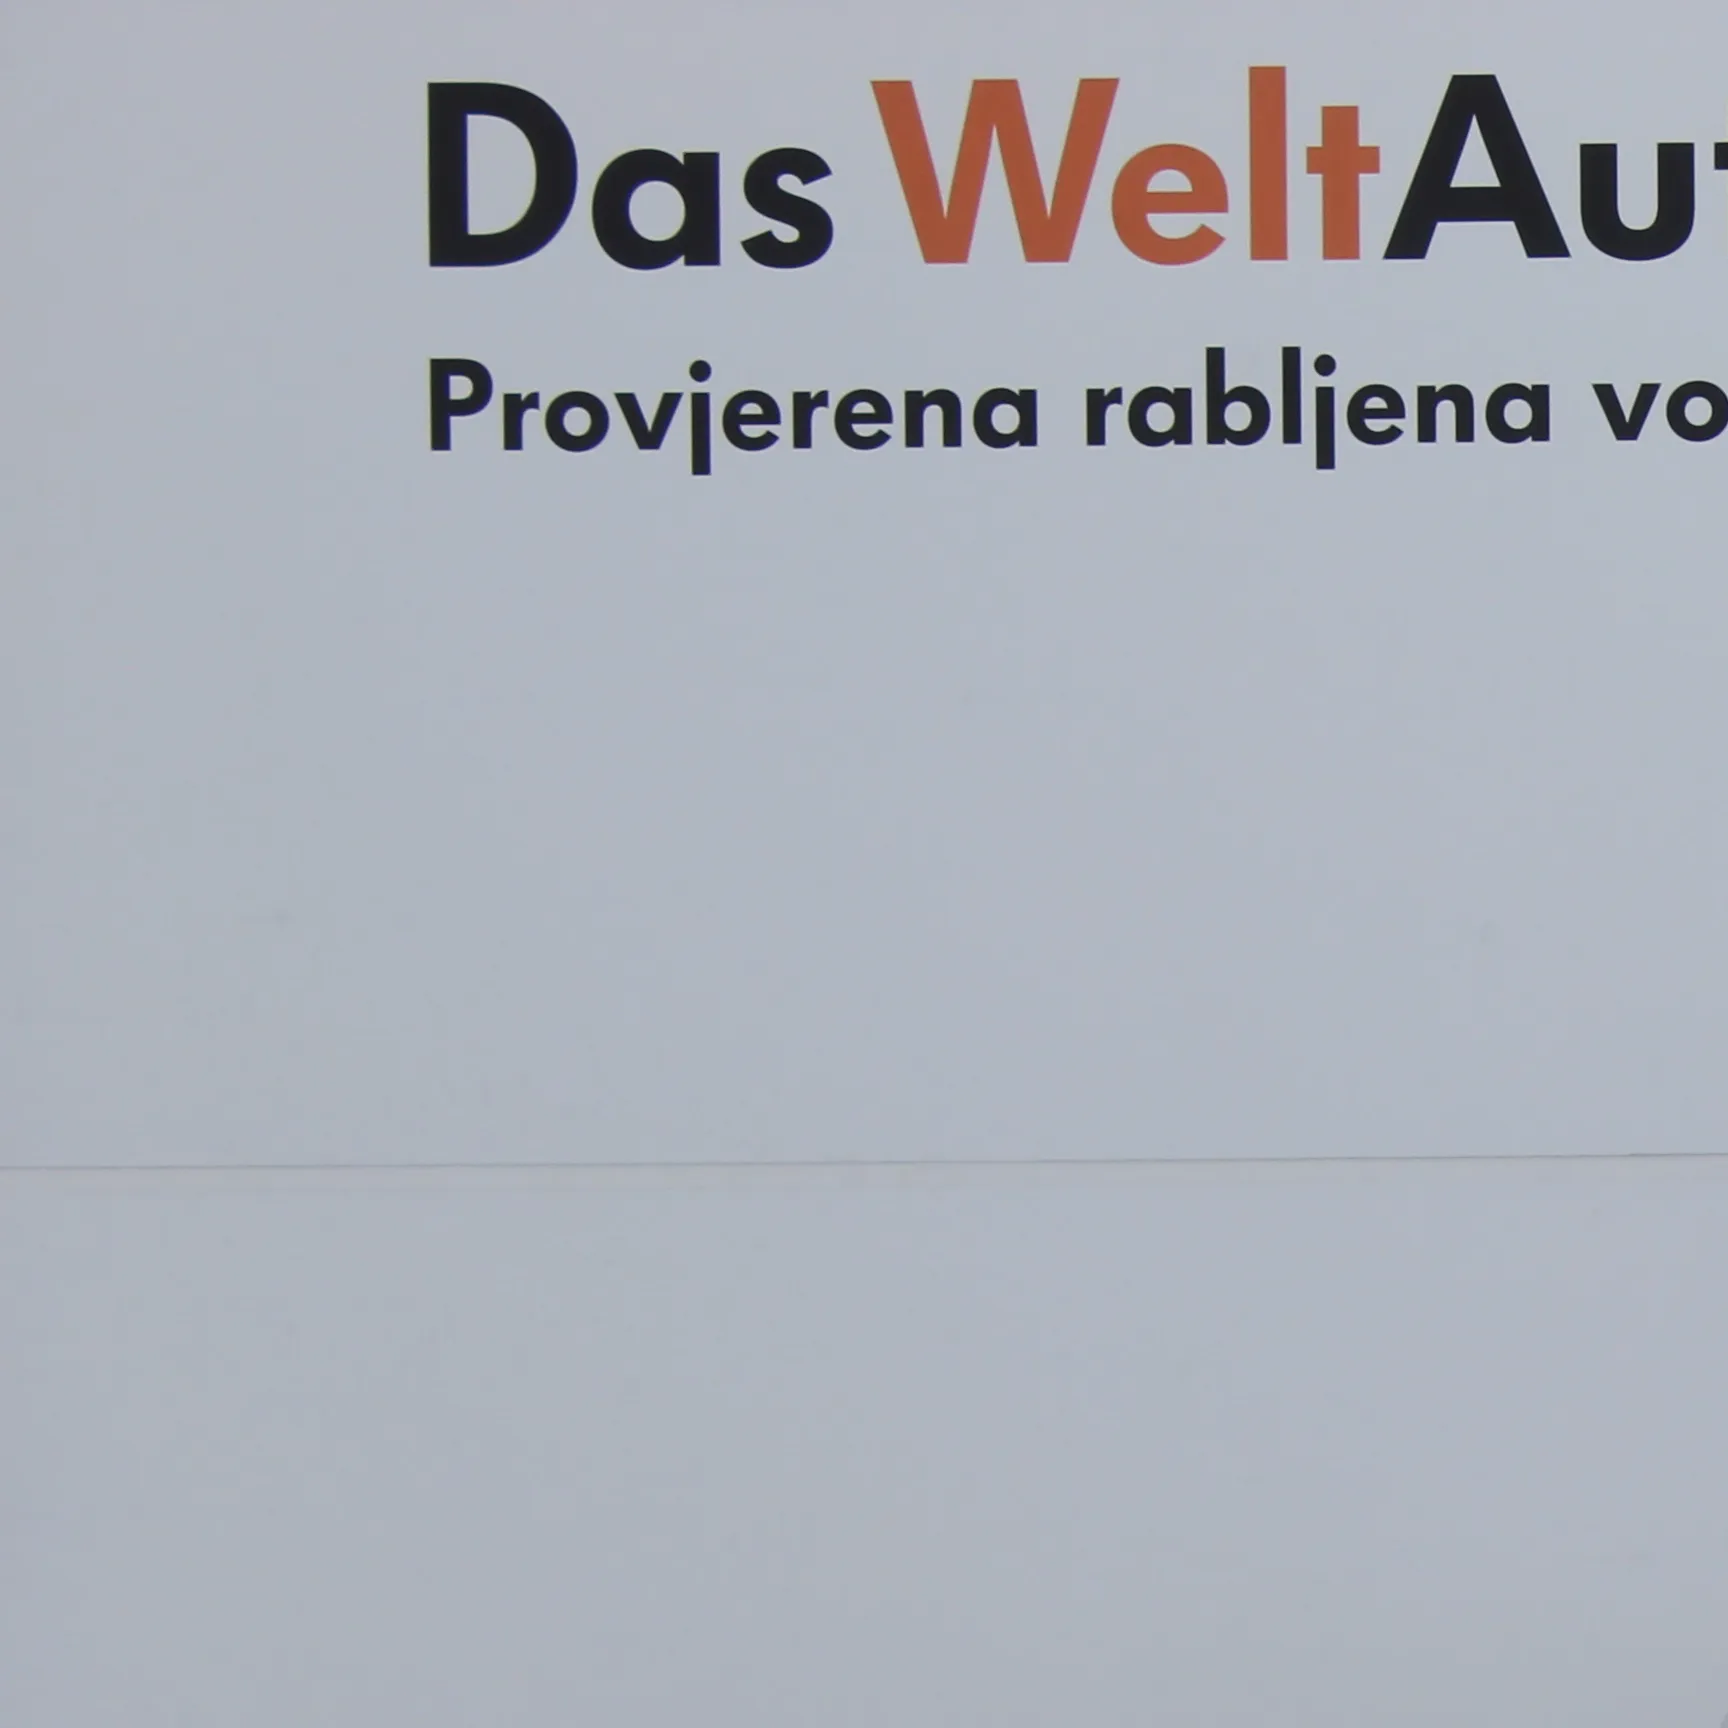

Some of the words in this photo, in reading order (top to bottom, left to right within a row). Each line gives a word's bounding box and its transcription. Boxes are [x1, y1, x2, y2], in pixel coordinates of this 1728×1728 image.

[427, 80, 834, 270] Das
[428, 357, 1039, 476] Provjerena
[1084, 345, 1551, 470] rabljena
